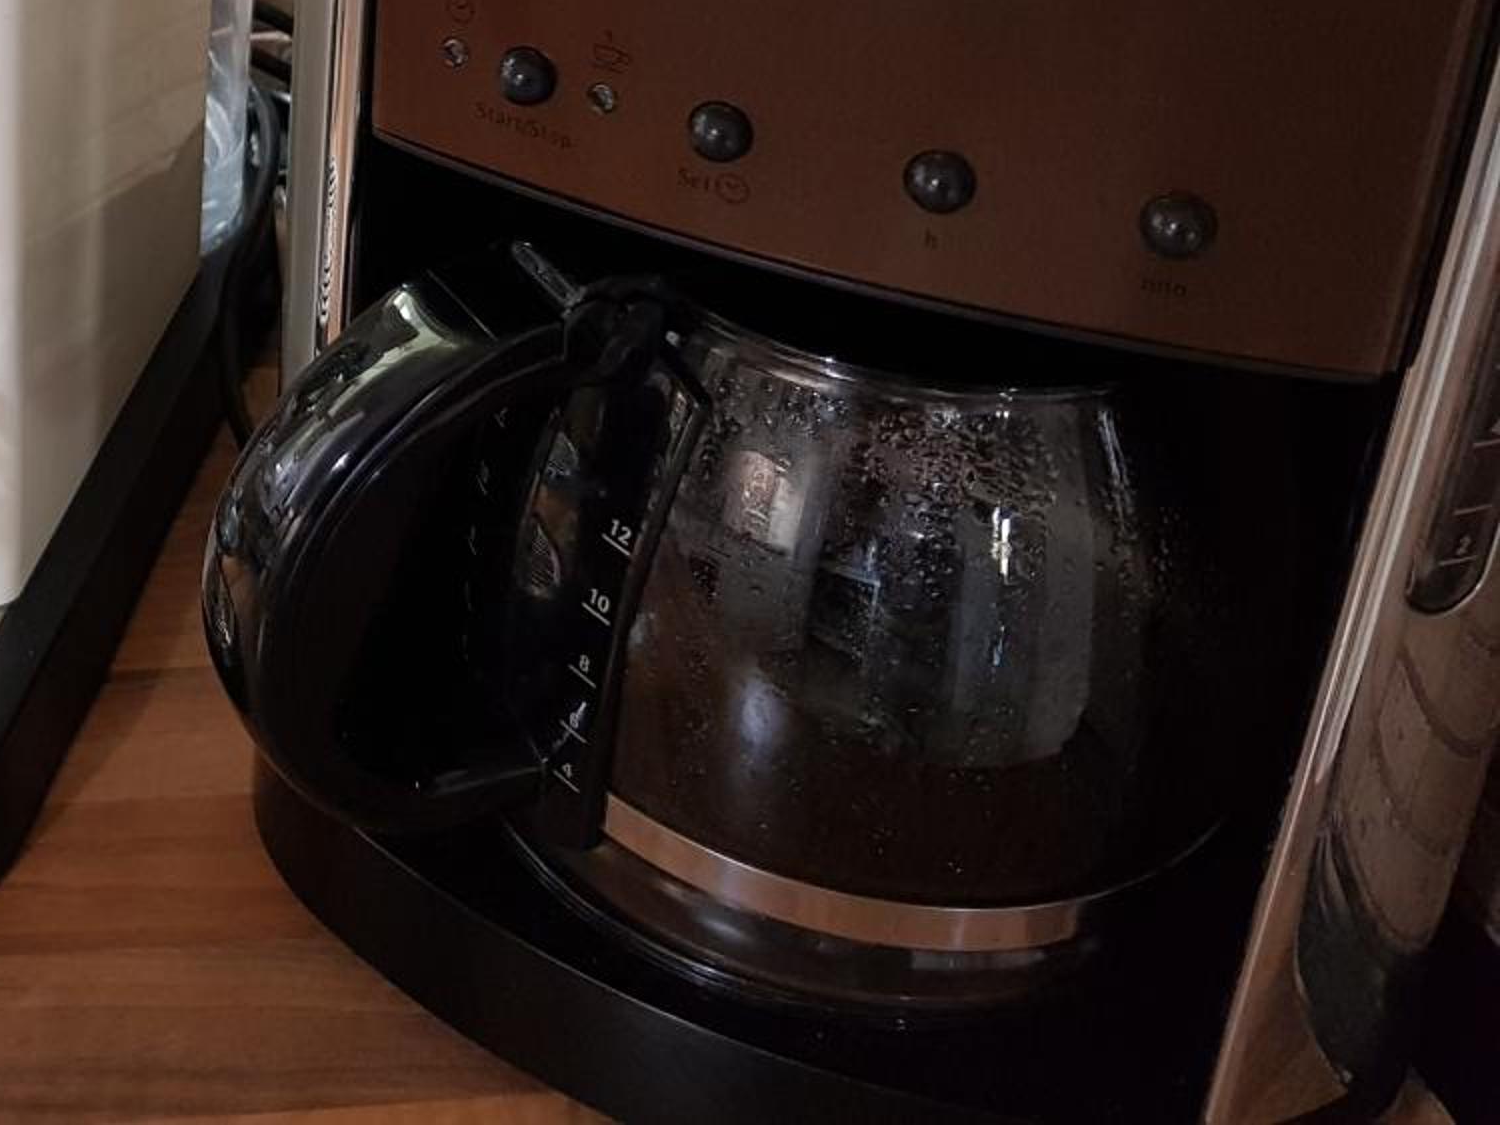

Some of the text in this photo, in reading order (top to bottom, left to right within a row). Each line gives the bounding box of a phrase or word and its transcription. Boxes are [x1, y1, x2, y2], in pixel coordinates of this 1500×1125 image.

[610, 519, 632, 546] 12
[588, 588, 609, 613] 10
[579, 655, 590, 673] 8
